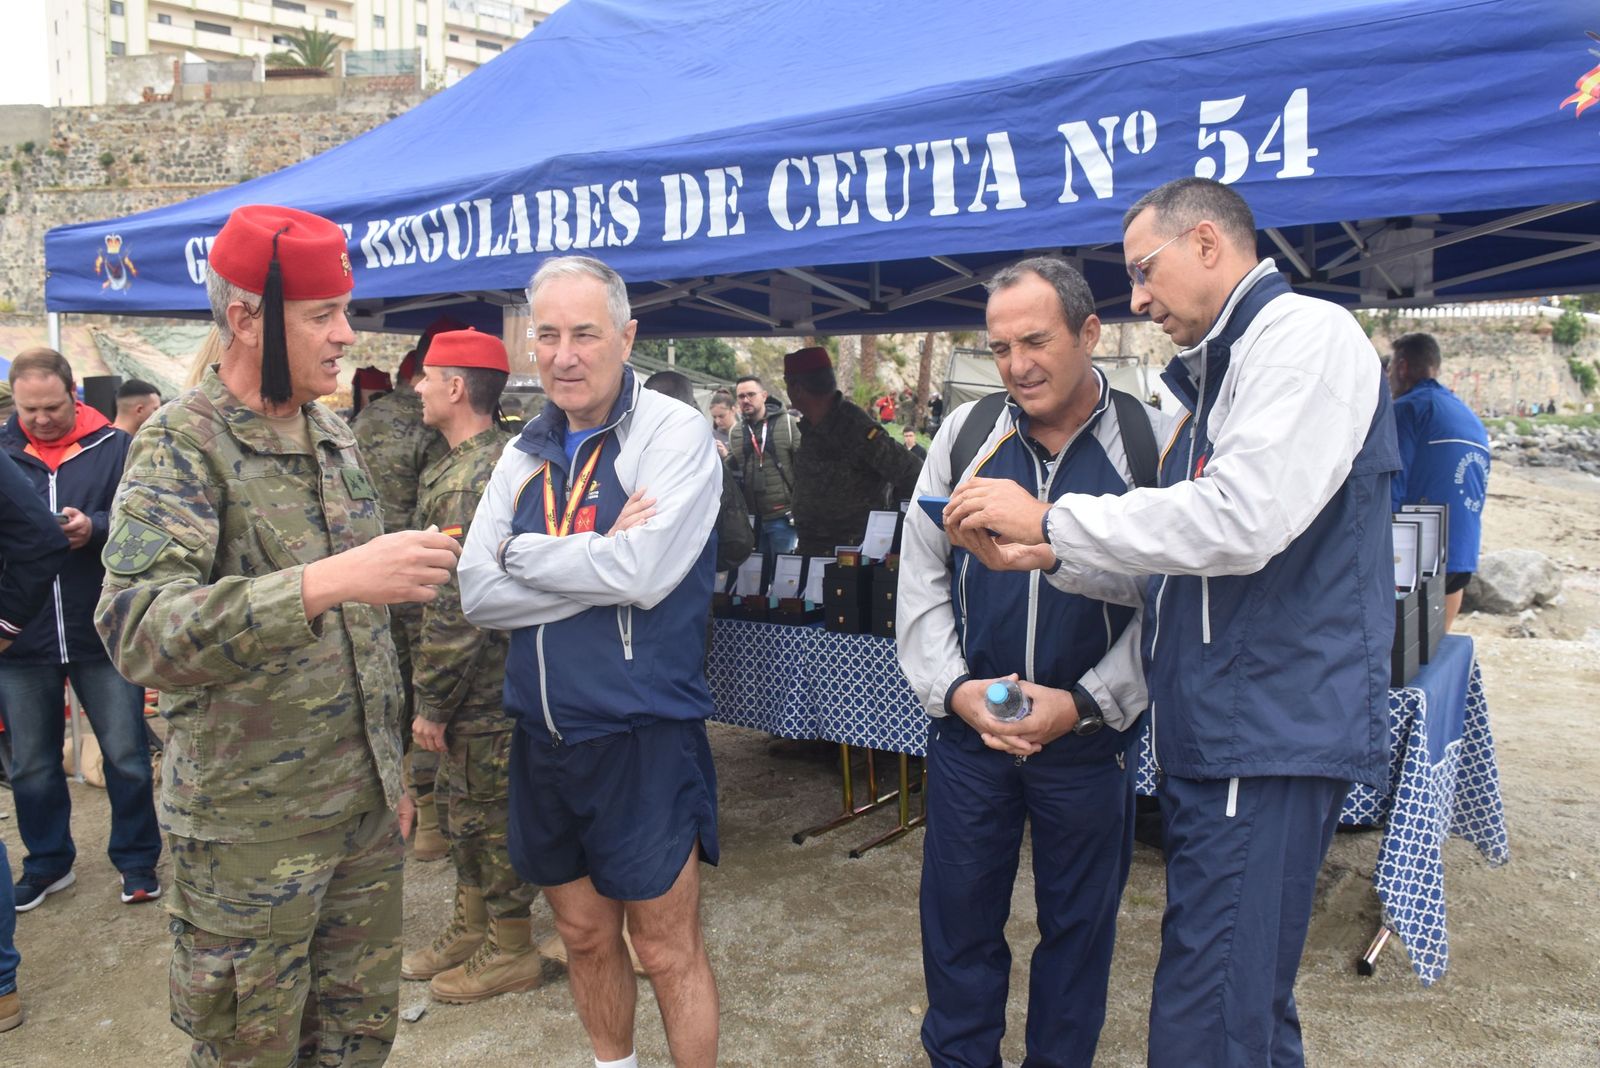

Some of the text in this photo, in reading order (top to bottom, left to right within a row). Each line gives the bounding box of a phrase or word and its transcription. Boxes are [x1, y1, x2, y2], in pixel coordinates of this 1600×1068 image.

[361, 179, 641, 269] REGULARES
[661, 166, 746, 242] DE
[767, 131, 1027, 231] CEUTA
[1194, 87, 1319, 185] 54
